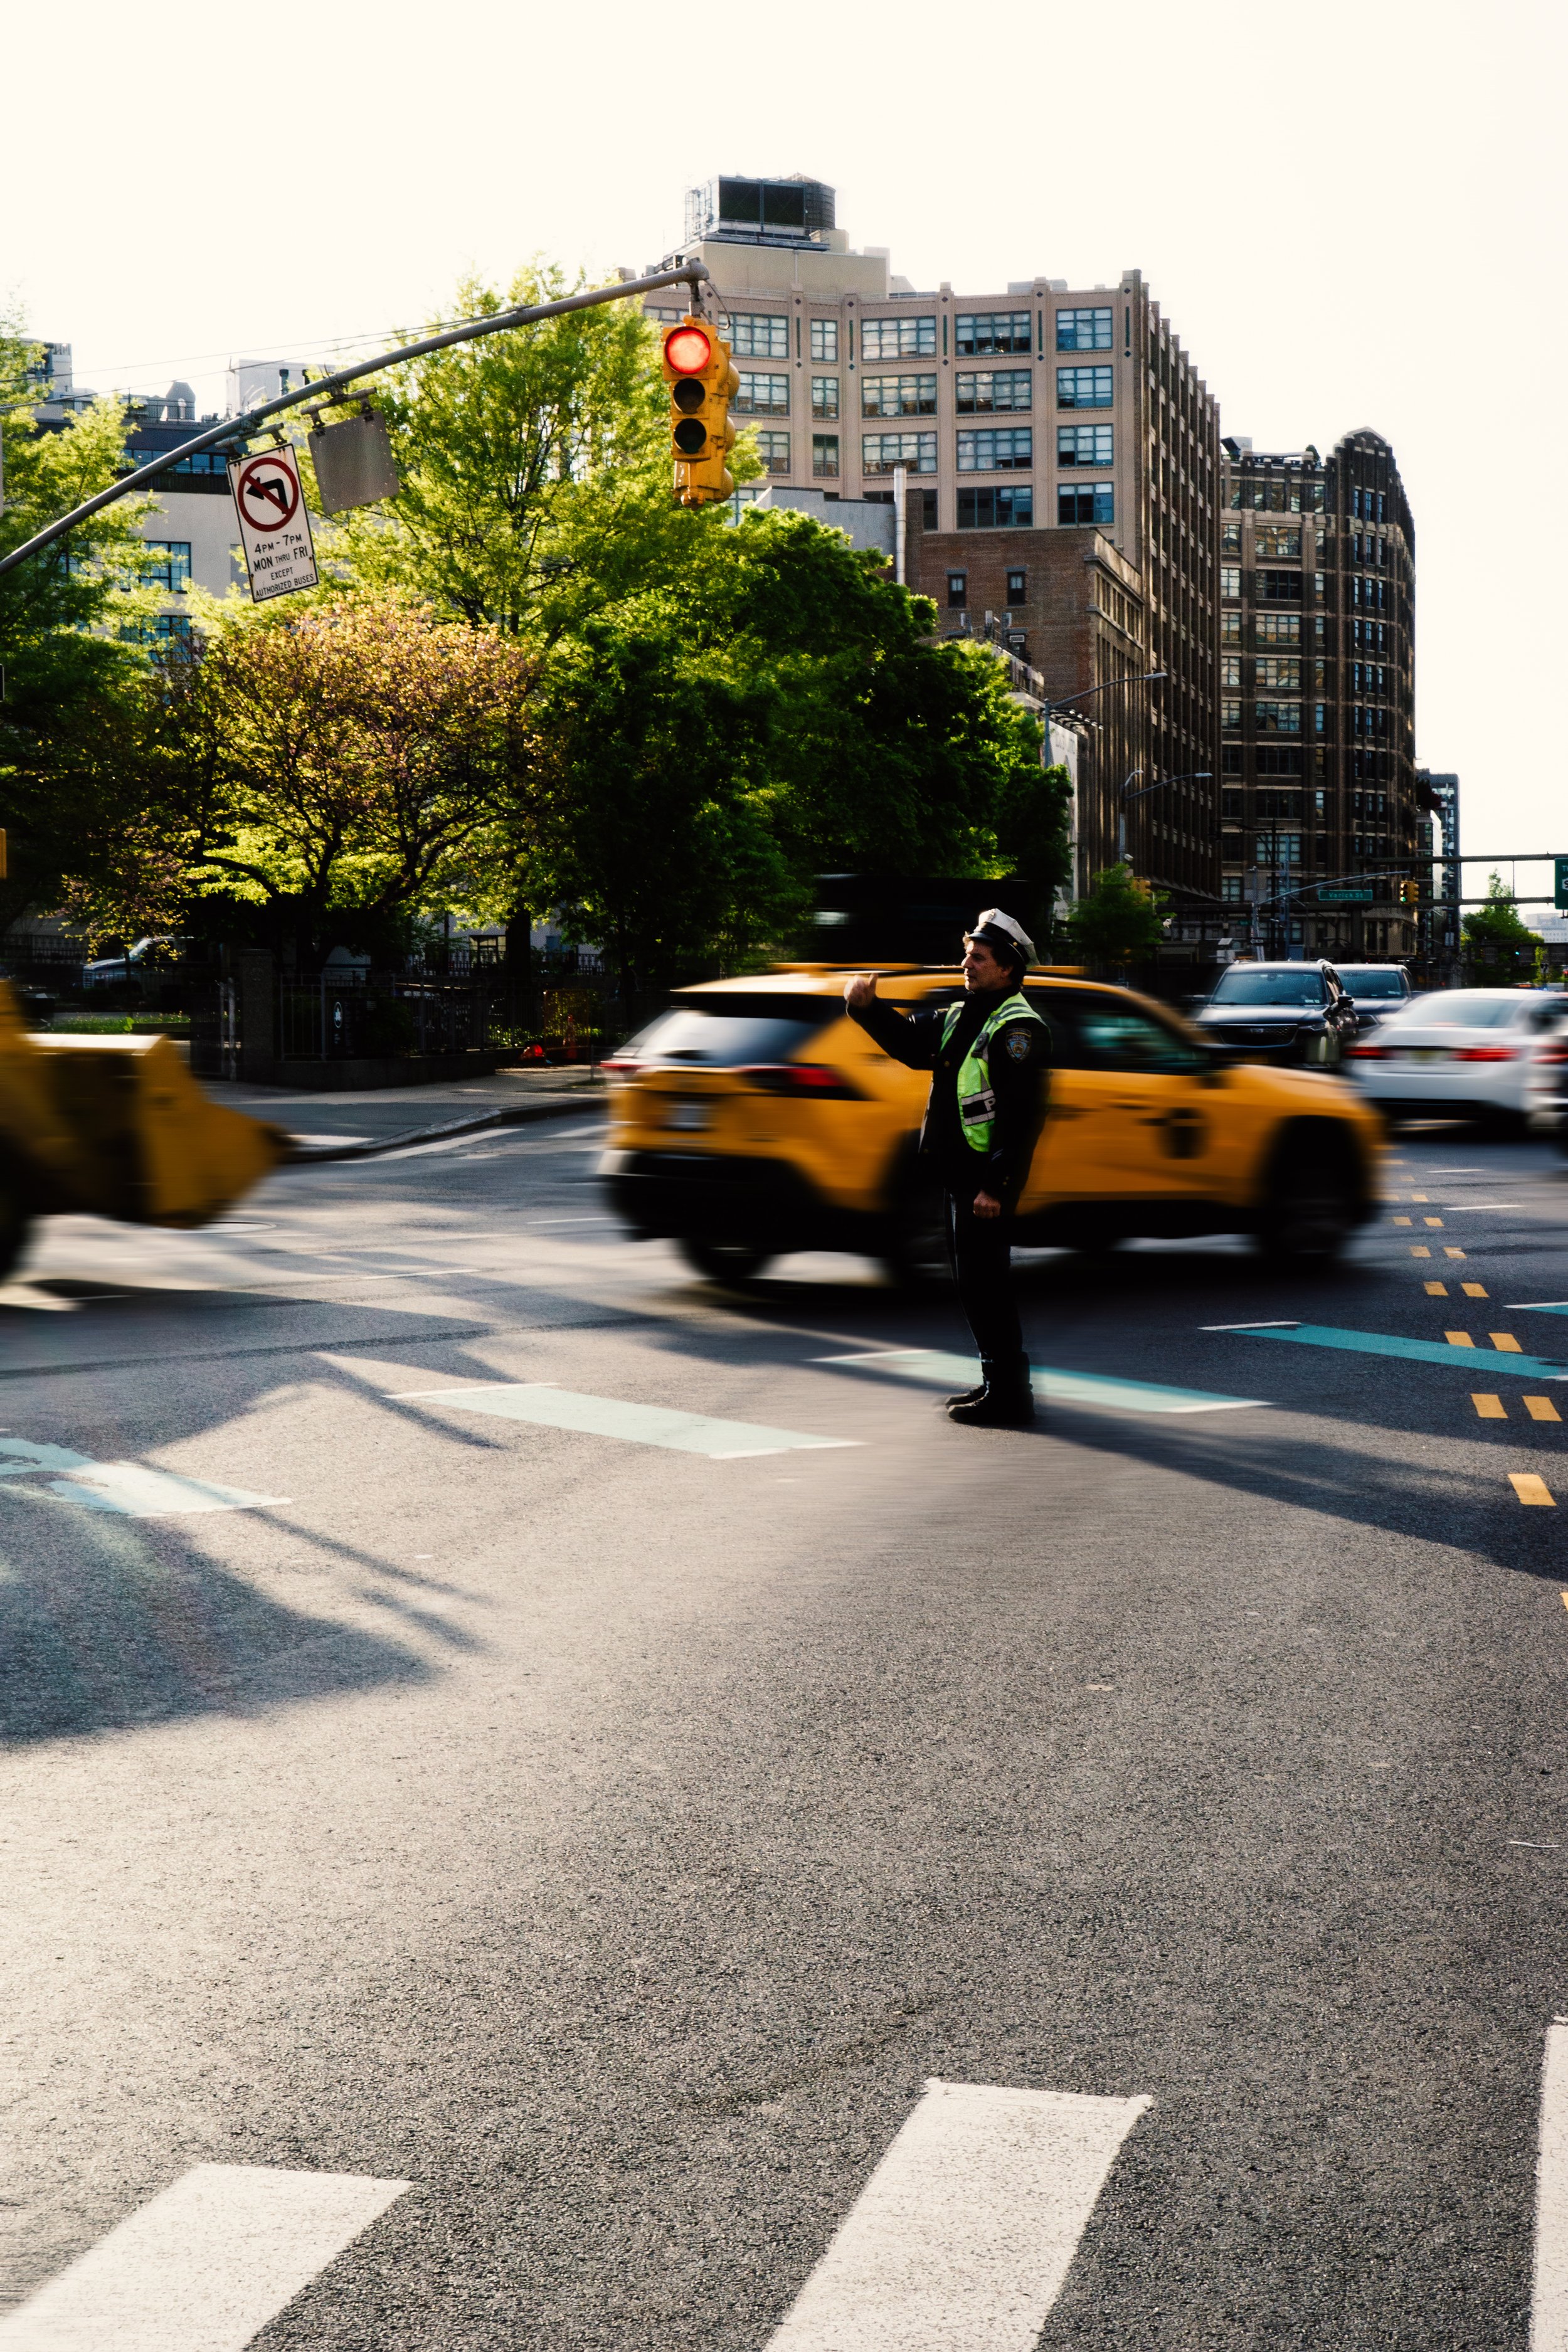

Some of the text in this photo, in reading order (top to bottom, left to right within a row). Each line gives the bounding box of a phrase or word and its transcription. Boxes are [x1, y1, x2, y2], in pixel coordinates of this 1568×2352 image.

[255, 542, 274, 554] 4PM
[282, 534, 302, 546] 7PM
[253, 545, 308, 571] MON THRU FRI
[270, 567, 293, 580] EXCEPT
[256, 573, 314, 597] AUTHORIZED BUSES
